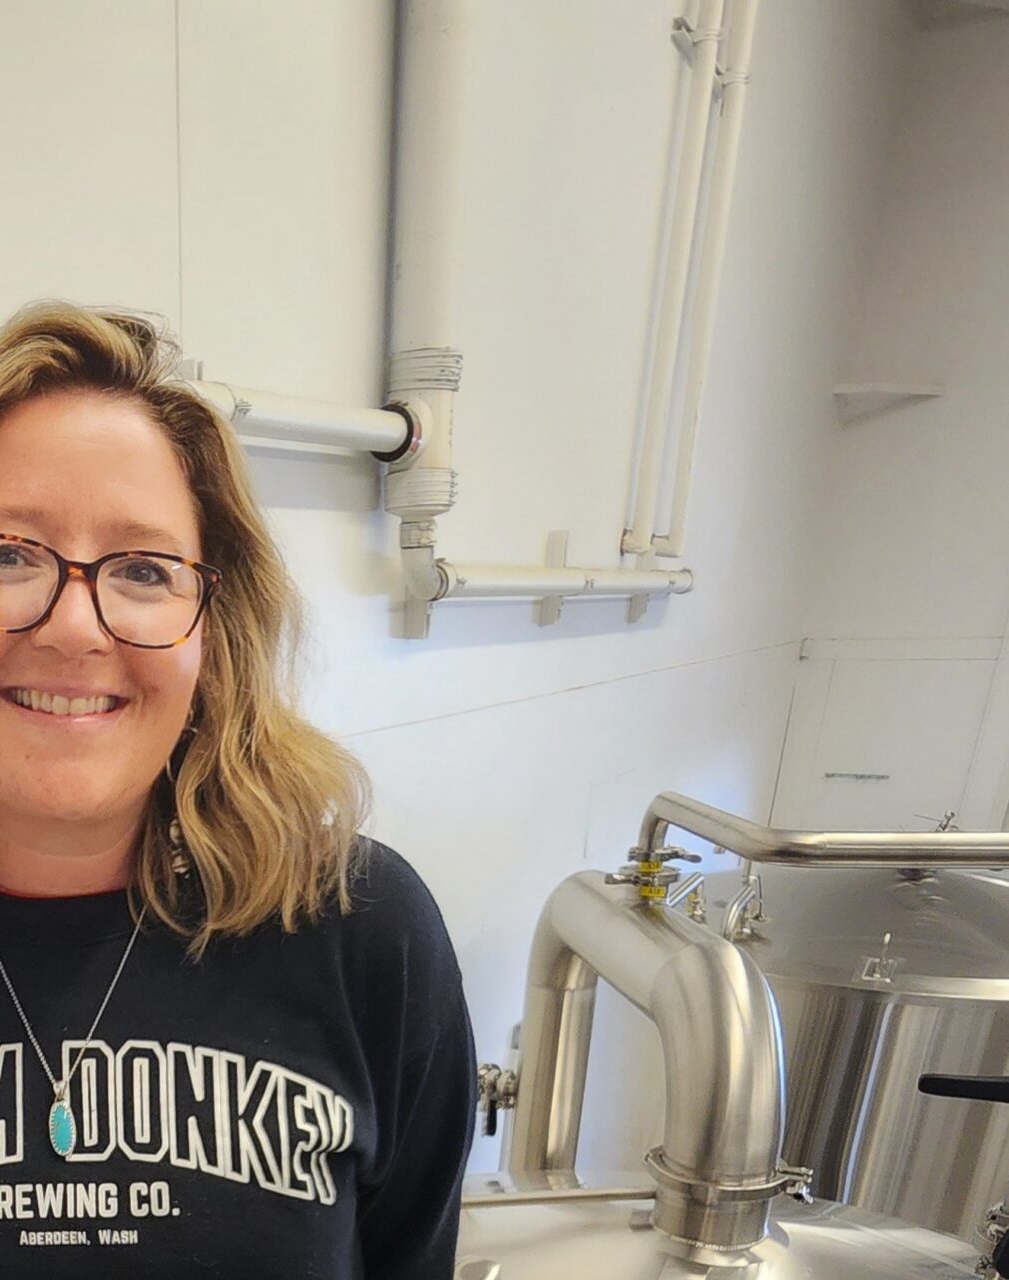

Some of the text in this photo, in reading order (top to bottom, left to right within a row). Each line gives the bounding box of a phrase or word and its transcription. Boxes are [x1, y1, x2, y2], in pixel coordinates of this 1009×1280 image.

[62, 1040, 354, 1206] DONKEY
[129, 1181, 180, 1217] CO.
[19, 1229, 138, 1246] ABERDEEN, WASH
